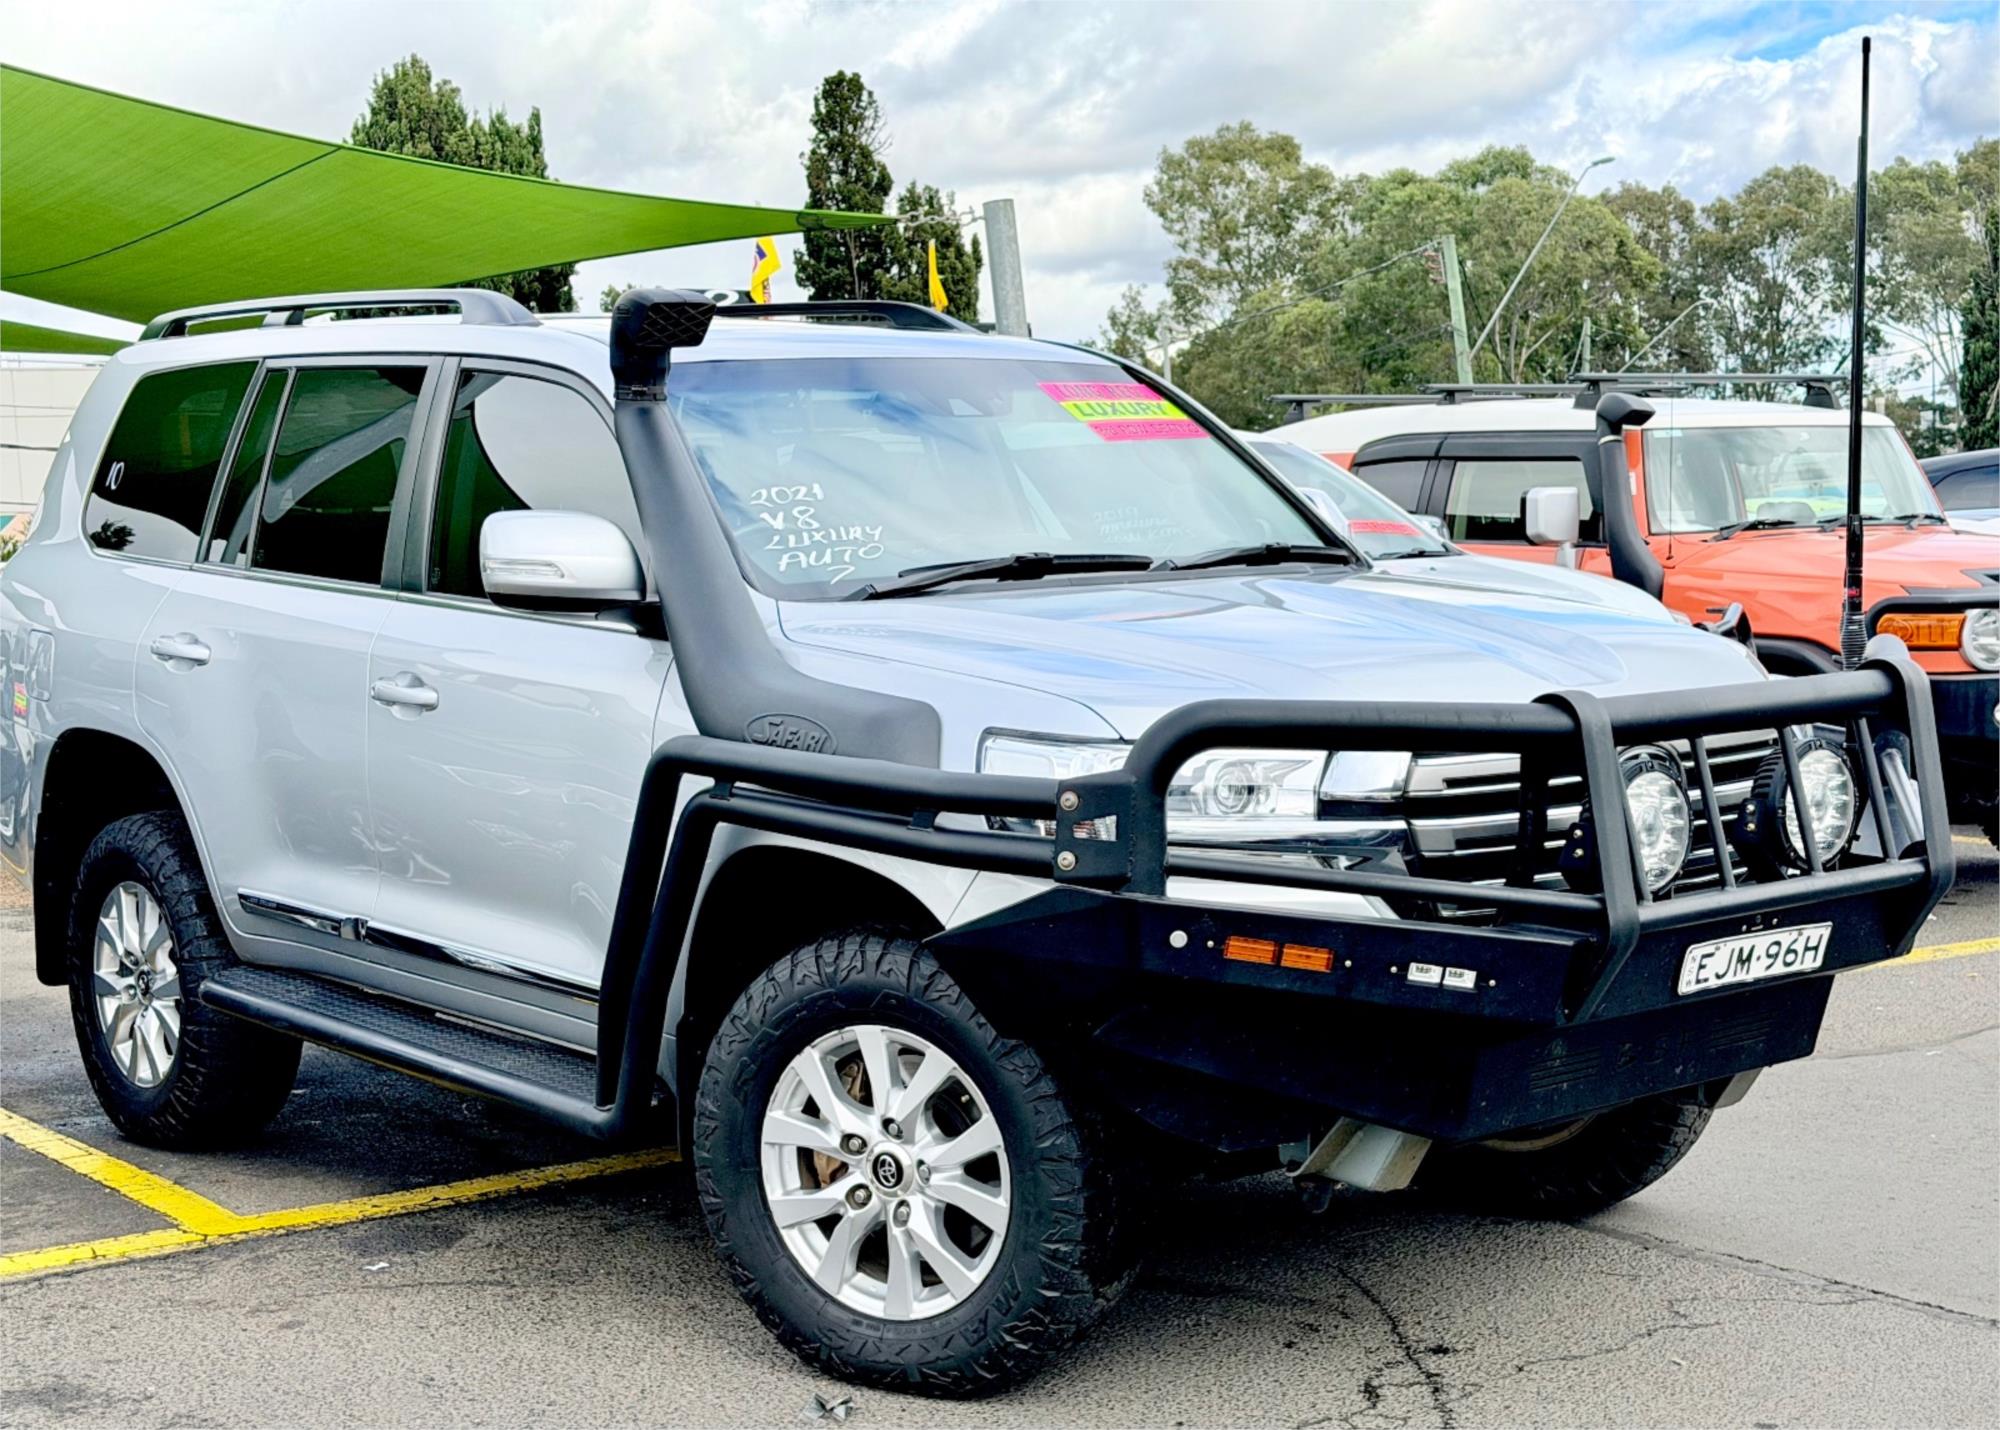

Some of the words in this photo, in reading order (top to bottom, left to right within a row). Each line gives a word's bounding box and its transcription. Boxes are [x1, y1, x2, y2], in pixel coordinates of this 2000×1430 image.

[1073, 401, 1168, 417] LUXURY
[105, 461, 125, 490] 10
[750, 483, 824, 507] 2021
[764, 525, 883, 550] LUXURY
[777, 543, 884, 572] AUTO
[752, 719, 829, 754] SAFARI
